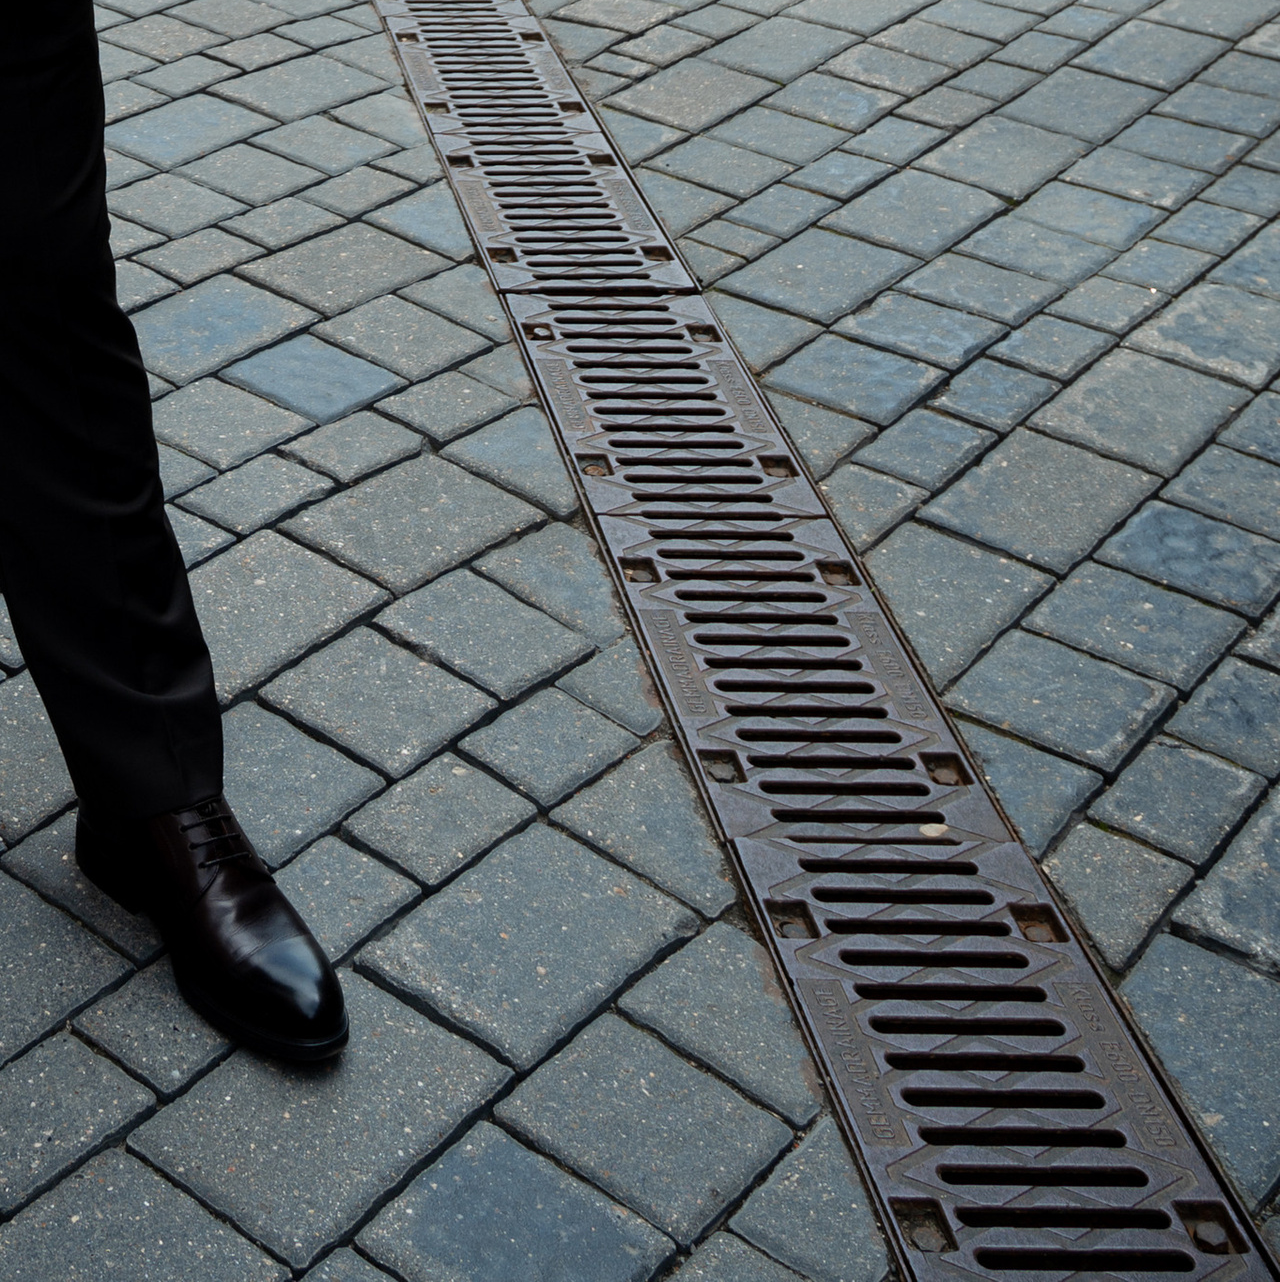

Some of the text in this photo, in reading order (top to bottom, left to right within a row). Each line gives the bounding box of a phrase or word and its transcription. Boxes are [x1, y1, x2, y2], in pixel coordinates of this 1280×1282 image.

[651, 614, 708, 714] GEMMADRAINAGE
[856, 612, 884, 646] Klass
[813, 986, 896, 1140] GEMMADRAINAGE
[1067, 982, 1107, 1033] Klass
[1098, 1041, 1141, 1083] E600
